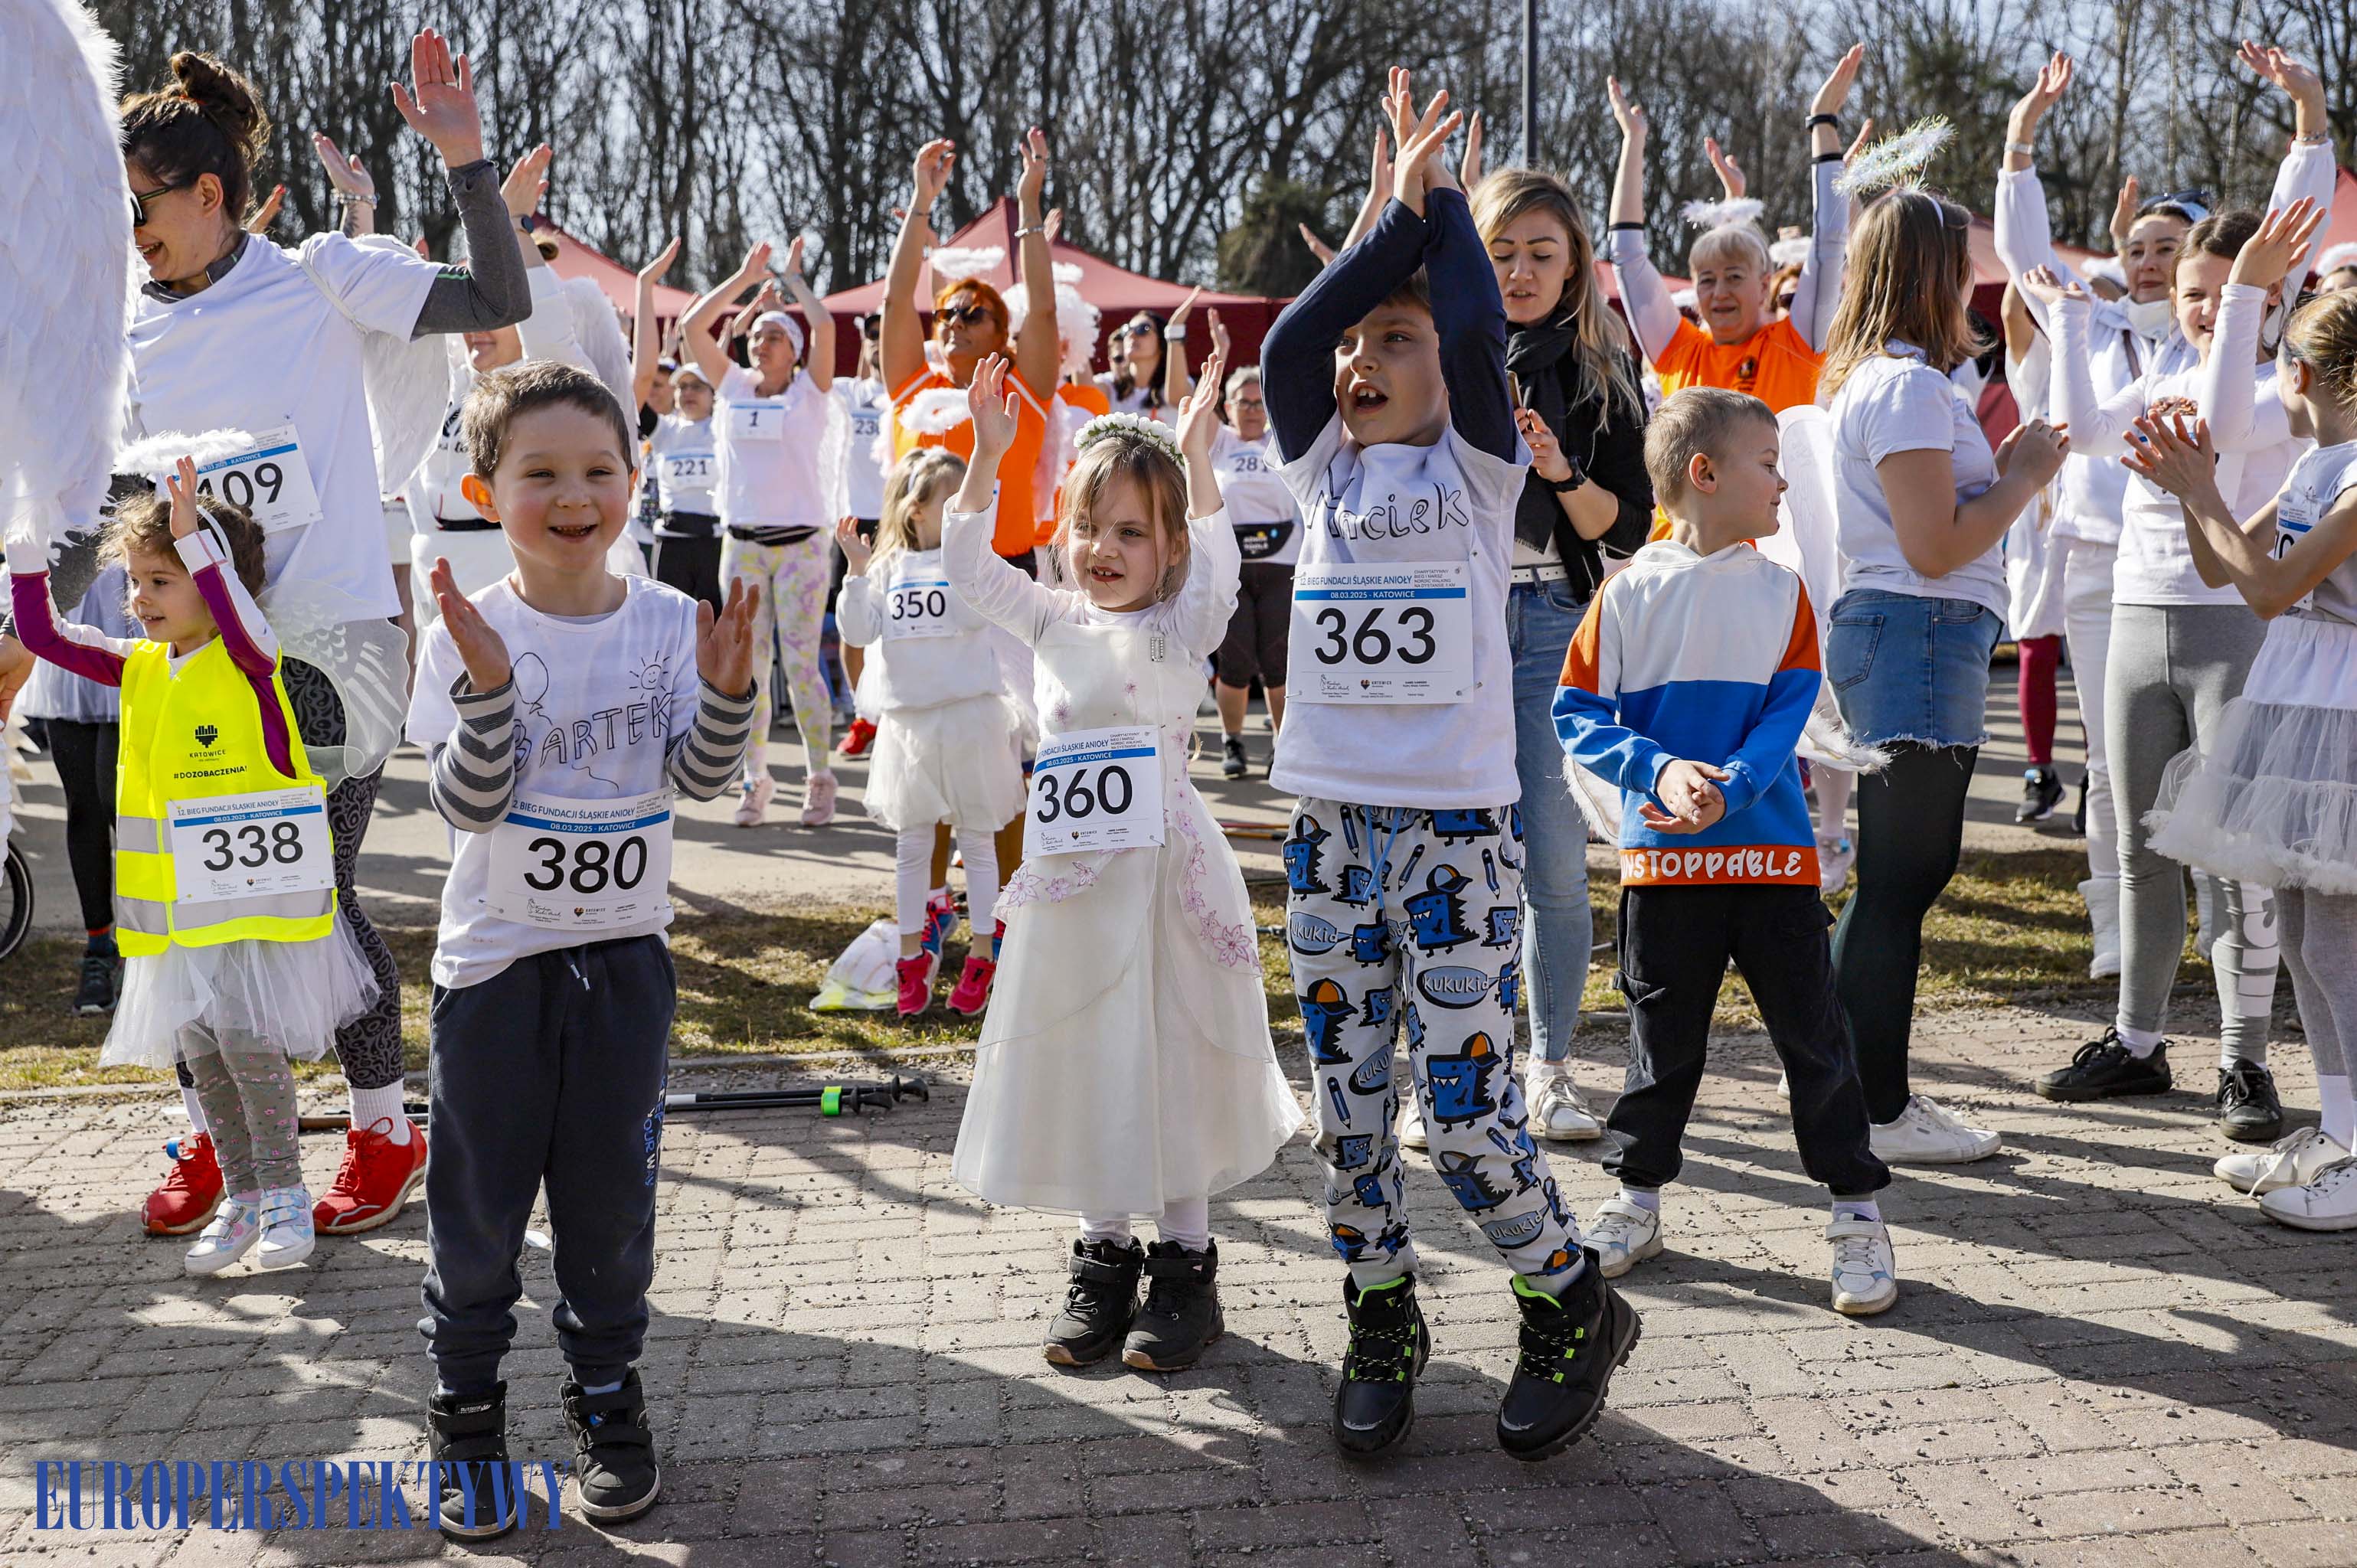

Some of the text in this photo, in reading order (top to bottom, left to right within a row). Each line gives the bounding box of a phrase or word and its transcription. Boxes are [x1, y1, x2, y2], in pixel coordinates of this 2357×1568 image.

[749, 410, 759, 427] 1
[673, 459, 708, 476] 221
[1320, 576, 1352, 585] FUNDACJI
[1352, 574, 1382, 586] ŚLĄSKIE
[1383, 575, 1413, 584] ANIOŁY
[891, 590, 946, 620] 350
[1314, 606, 1436, 665] 363
[189, 749, 227, 759] KATOWICE
[1061, 741, 1084, 753] ŚLĄSKIE
[1084, 739, 1110, 749] ANIOŁY
[1077, 751, 1113, 762] KATOWICE
[173, 765, 248, 779] #DOZOBACZENIA!
[1036, 765, 1133, 824] 360
[201, 805, 232, 814] FUNDACJI
[232, 801, 257, 812] ŚLĄSKIE
[257, 799, 280, 808] ANIOŁY
[519, 802, 538, 812] BIEG
[538, 806, 578, 819] FUNDACJI
[578, 809, 609, 821] ŚLĄSKIE
[610, 807, 636, 818] ANIOŁY
[214, 813, 247, 823] 08.03.2025
[250, 810, 283, 819] KATOWICE
[551, 822, 593, 832] 08.03.2025
[598, 822, 636, 832] KATOWICE
[202, 821, 304, 871] 338
[524, 835, 648, 893] 380
[1620, 848, 1802, 879] UNSTOPPABLE
